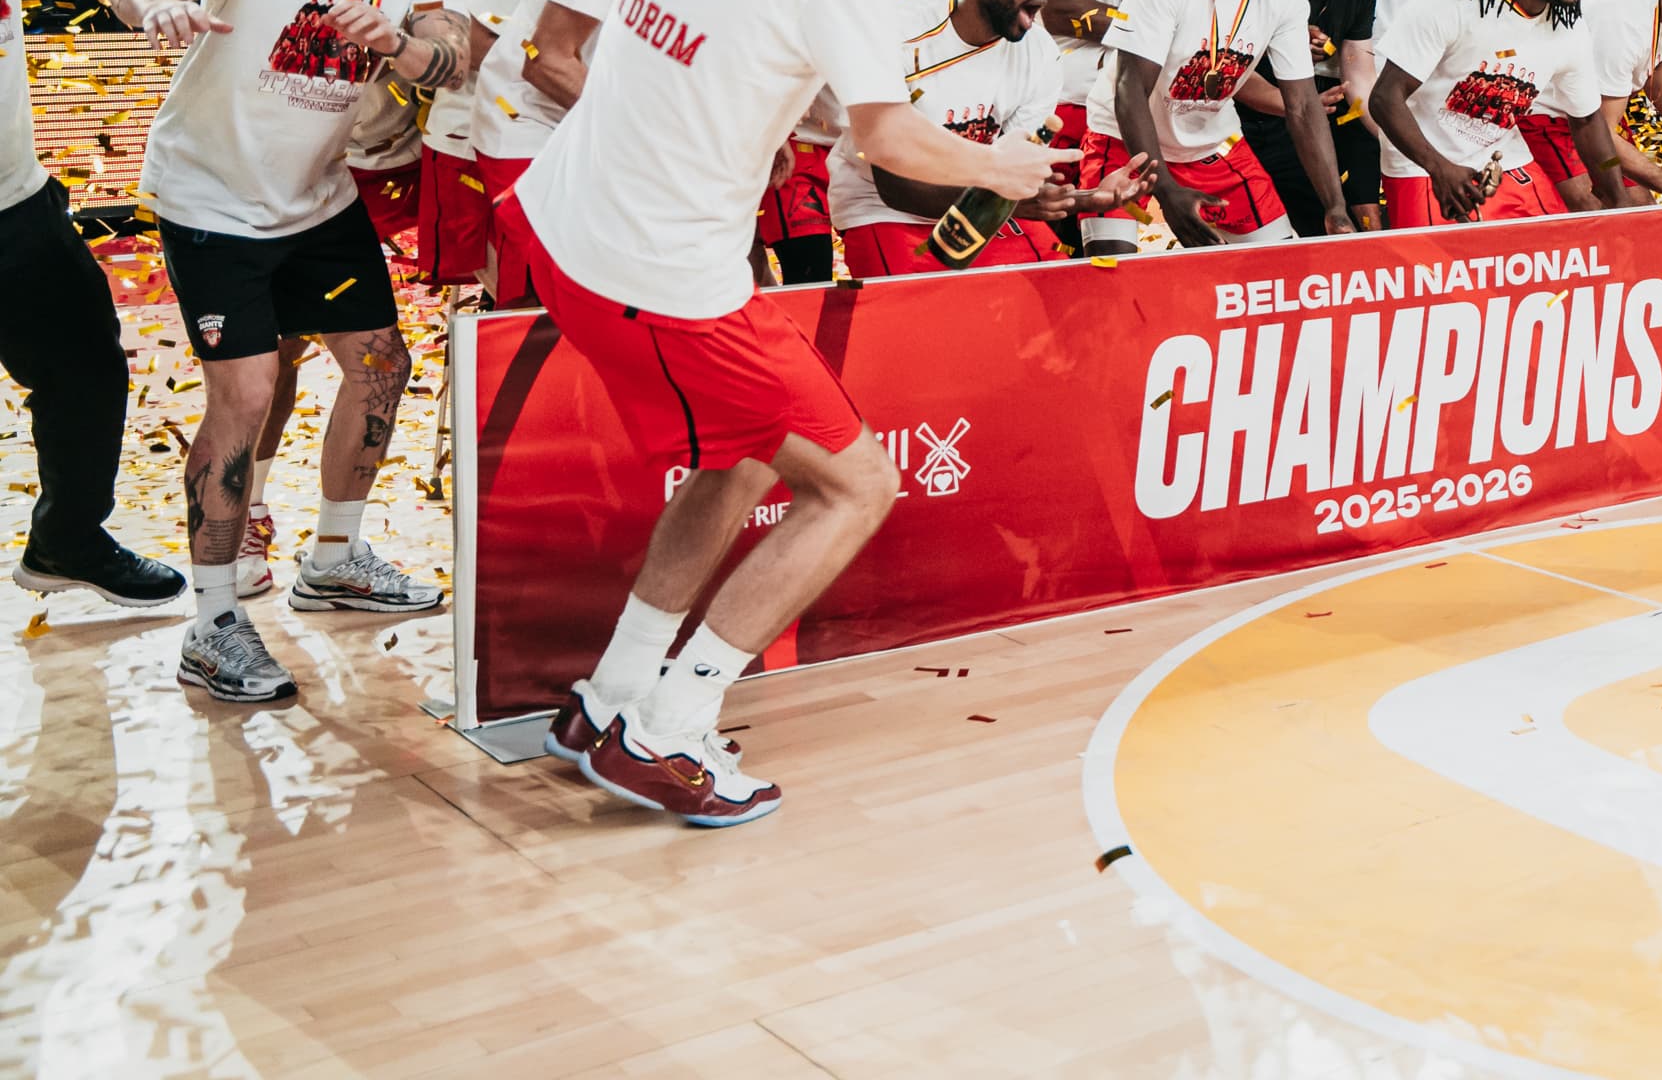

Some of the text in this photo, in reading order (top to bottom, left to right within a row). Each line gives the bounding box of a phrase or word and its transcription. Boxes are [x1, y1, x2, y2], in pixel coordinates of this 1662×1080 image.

[1215, 246, 1610, 319] BELGIAN NATIONAL
[1314, 463, 1532, 534] 2025-2026
